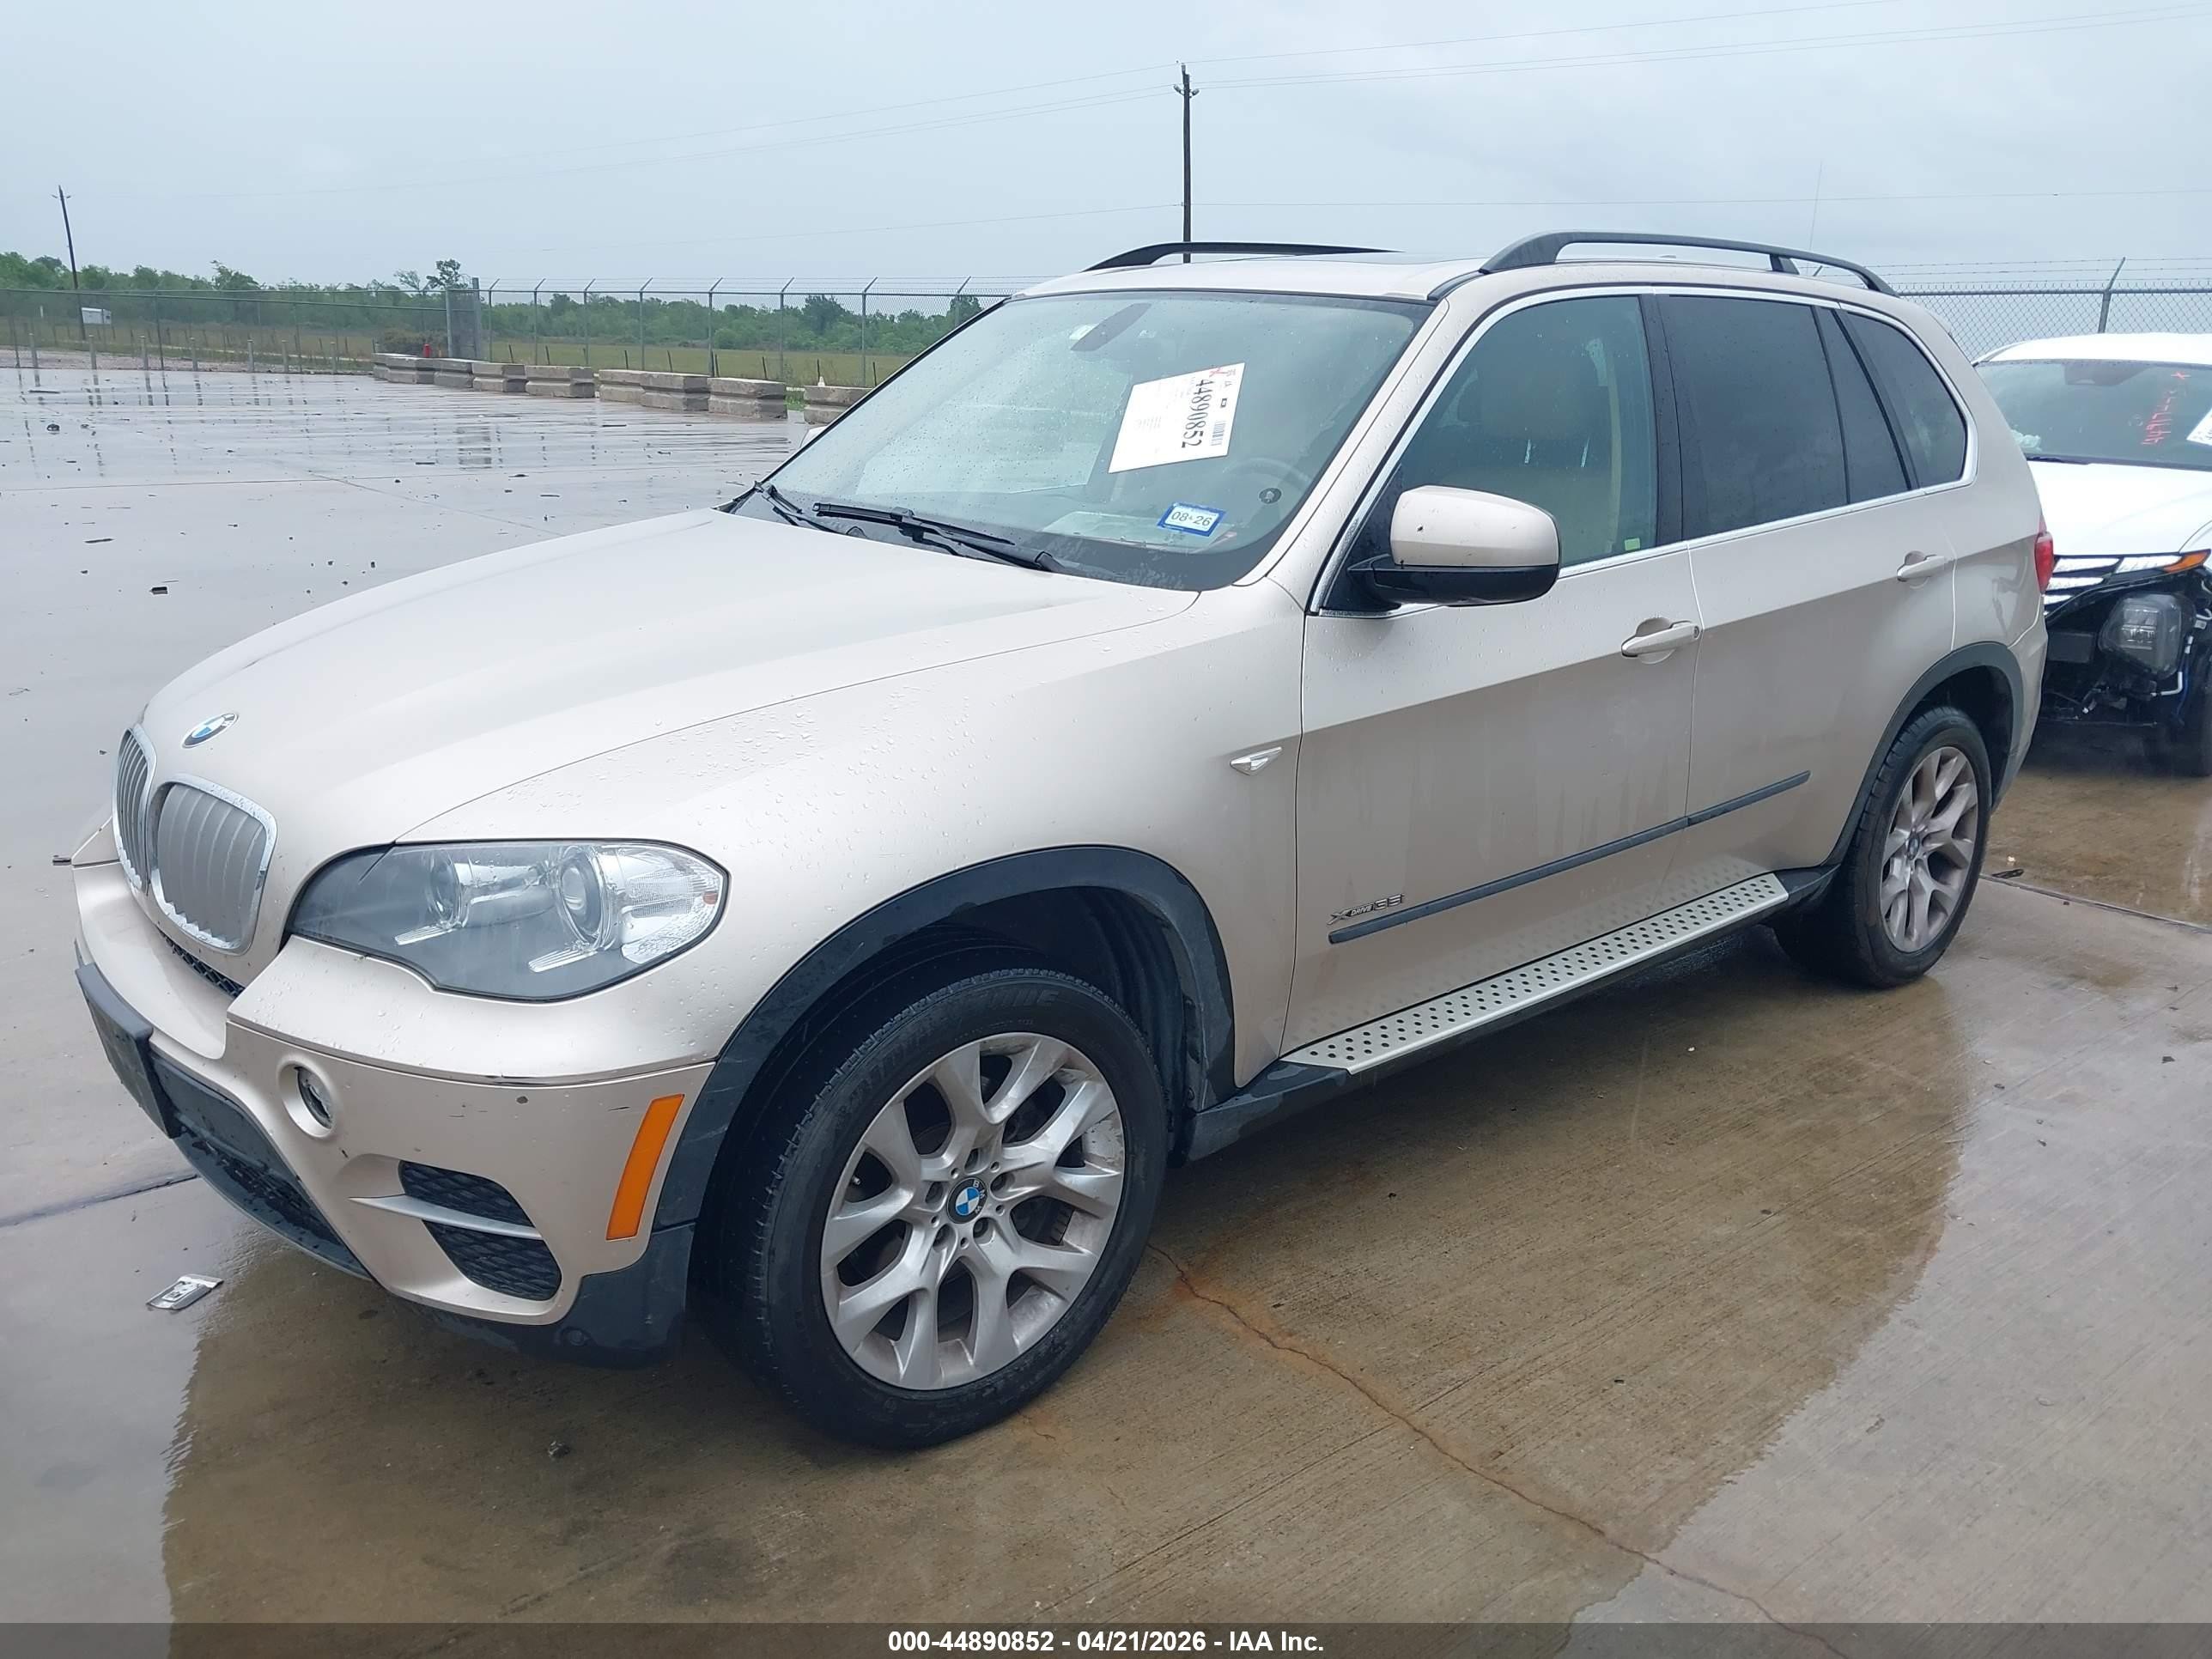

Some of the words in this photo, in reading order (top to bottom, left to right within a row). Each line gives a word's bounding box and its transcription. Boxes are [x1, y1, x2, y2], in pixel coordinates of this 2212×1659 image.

[1182, 378, 1215, 448] 44890852
[1171, 510, 1188, 522] 08
[1193, 514, 1211, 526] 26
